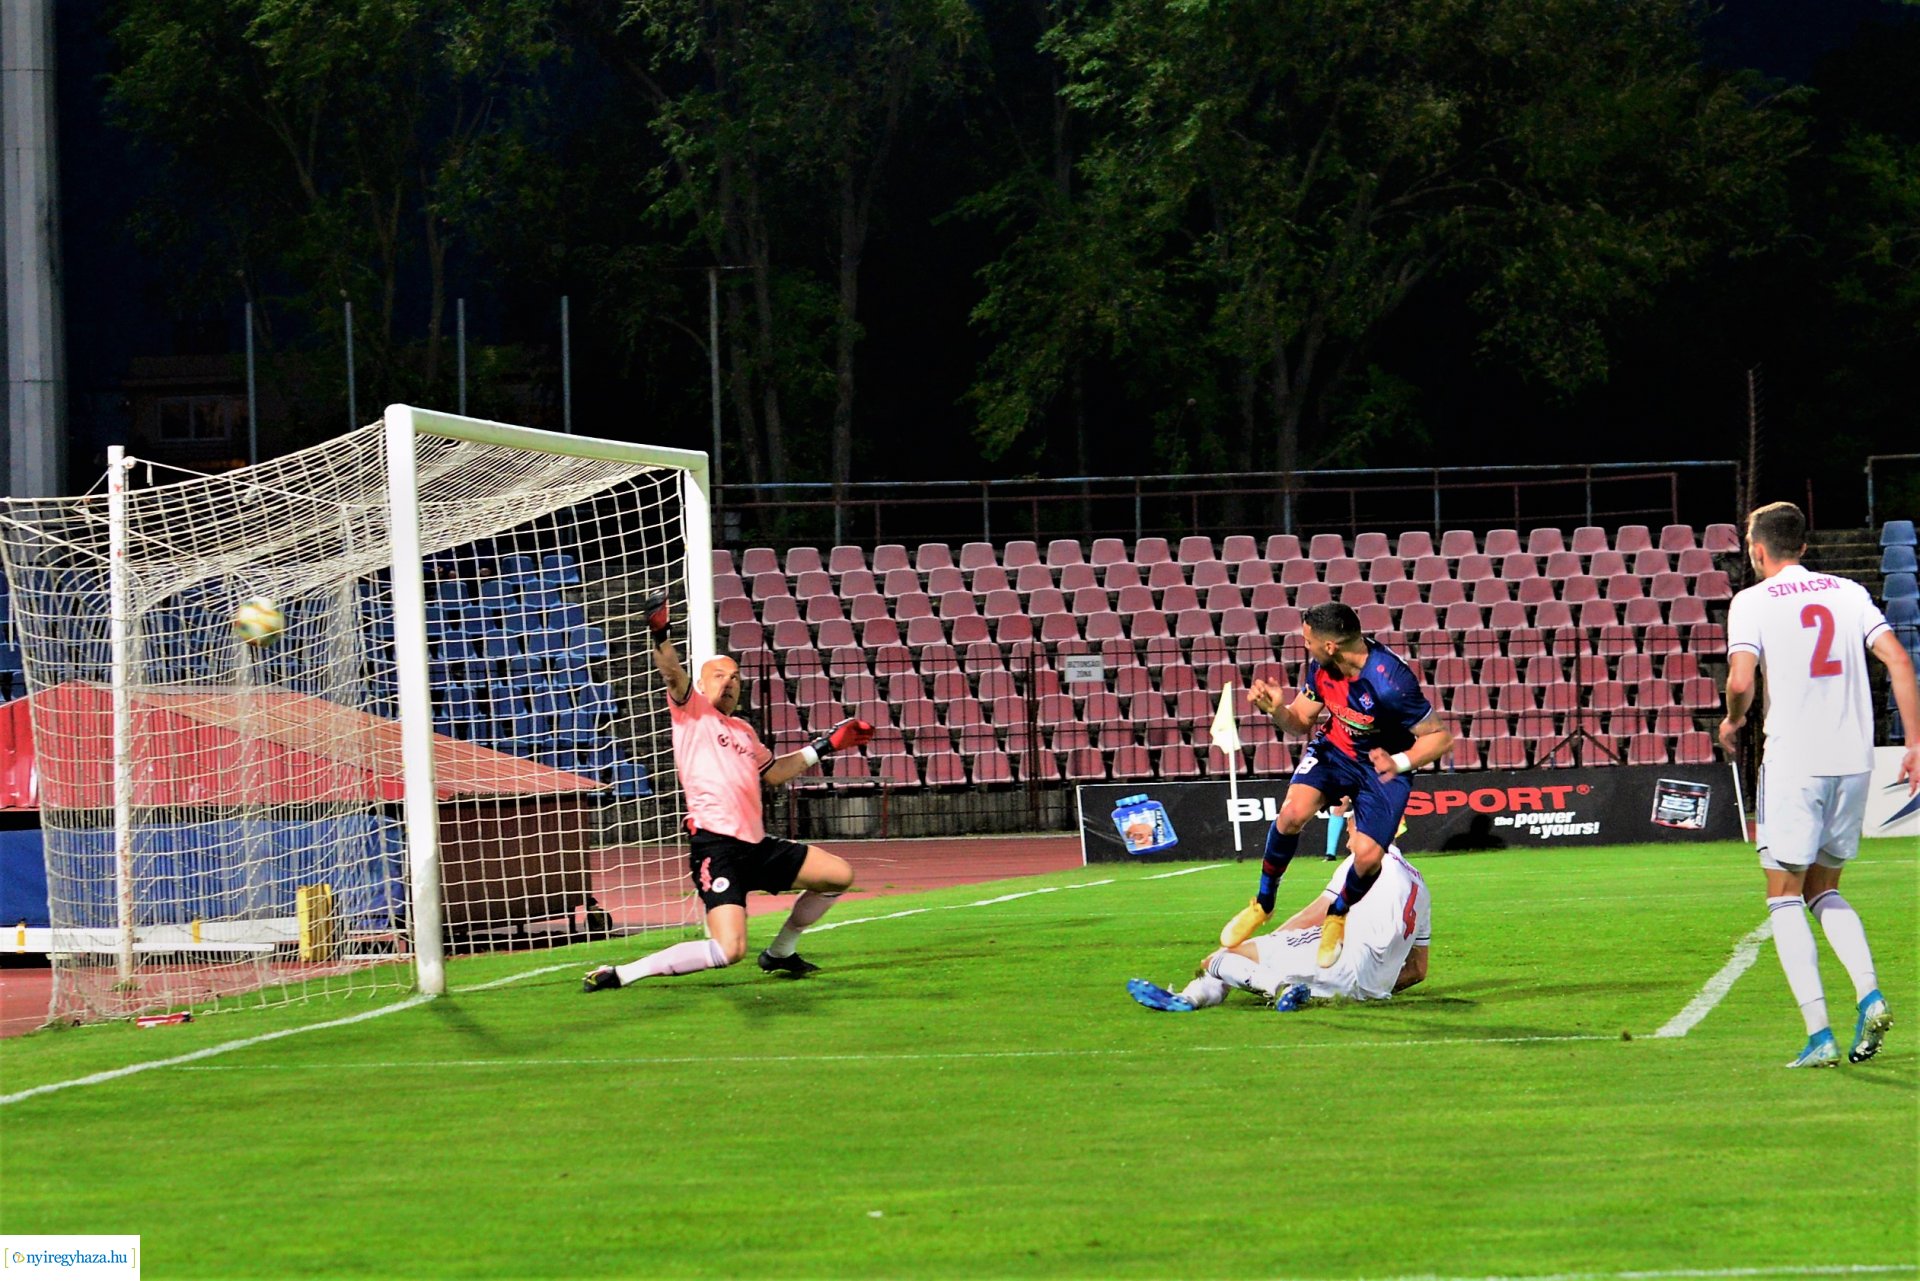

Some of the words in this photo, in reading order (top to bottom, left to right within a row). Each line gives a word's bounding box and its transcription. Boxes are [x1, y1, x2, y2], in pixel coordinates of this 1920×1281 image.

[1767, 578, 1840, 597] SZIVACSKI
[1800, 604, 1843, 678] 2
[1494, 816, 1514, 826] the
[1514, 811, 1576, 828] power
[1529, 825, 1541, 835] is
[1541, 821, 1600, 839] yours!
[1402, 881, 1419, 941] 4
